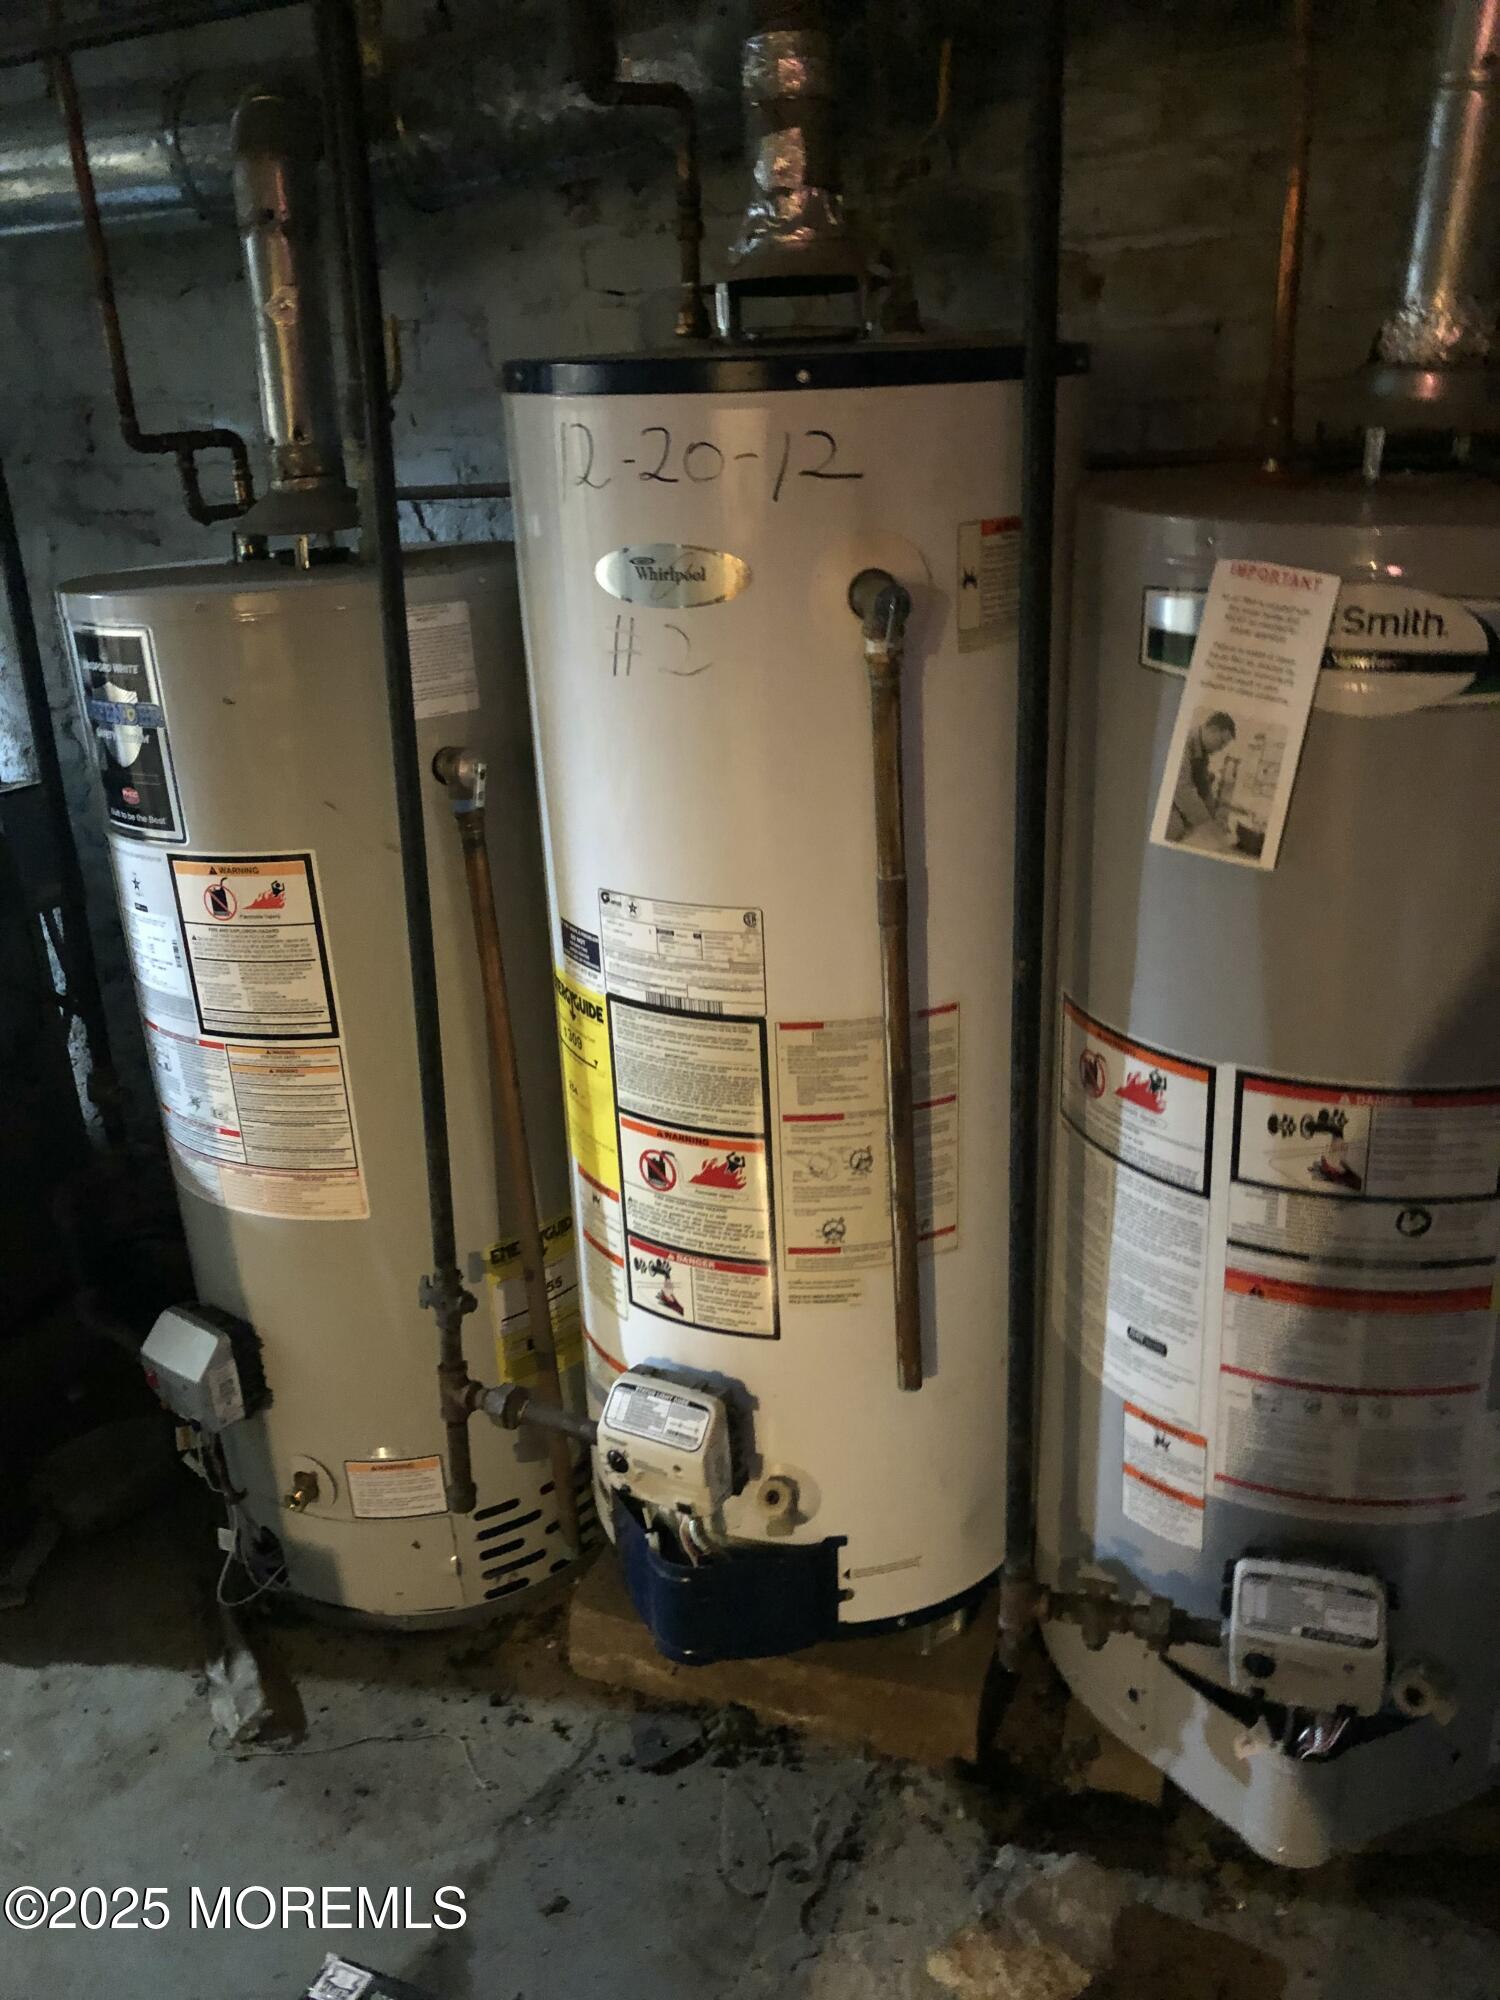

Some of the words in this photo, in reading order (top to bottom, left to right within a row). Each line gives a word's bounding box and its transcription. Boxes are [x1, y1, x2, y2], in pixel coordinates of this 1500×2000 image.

[561, 422, 864, 502] 12-20-12
[634, 564, 706, 585] Whirlpool
[1230, 563, 1323, 592] IMPORTANT
[1342, 604, 1446, 638] Smith
[219, 866, 260, 875] WARNING
[663, 1131, 710, 1147] WARNING
[676, 1254, 716, 1270] DANGER
